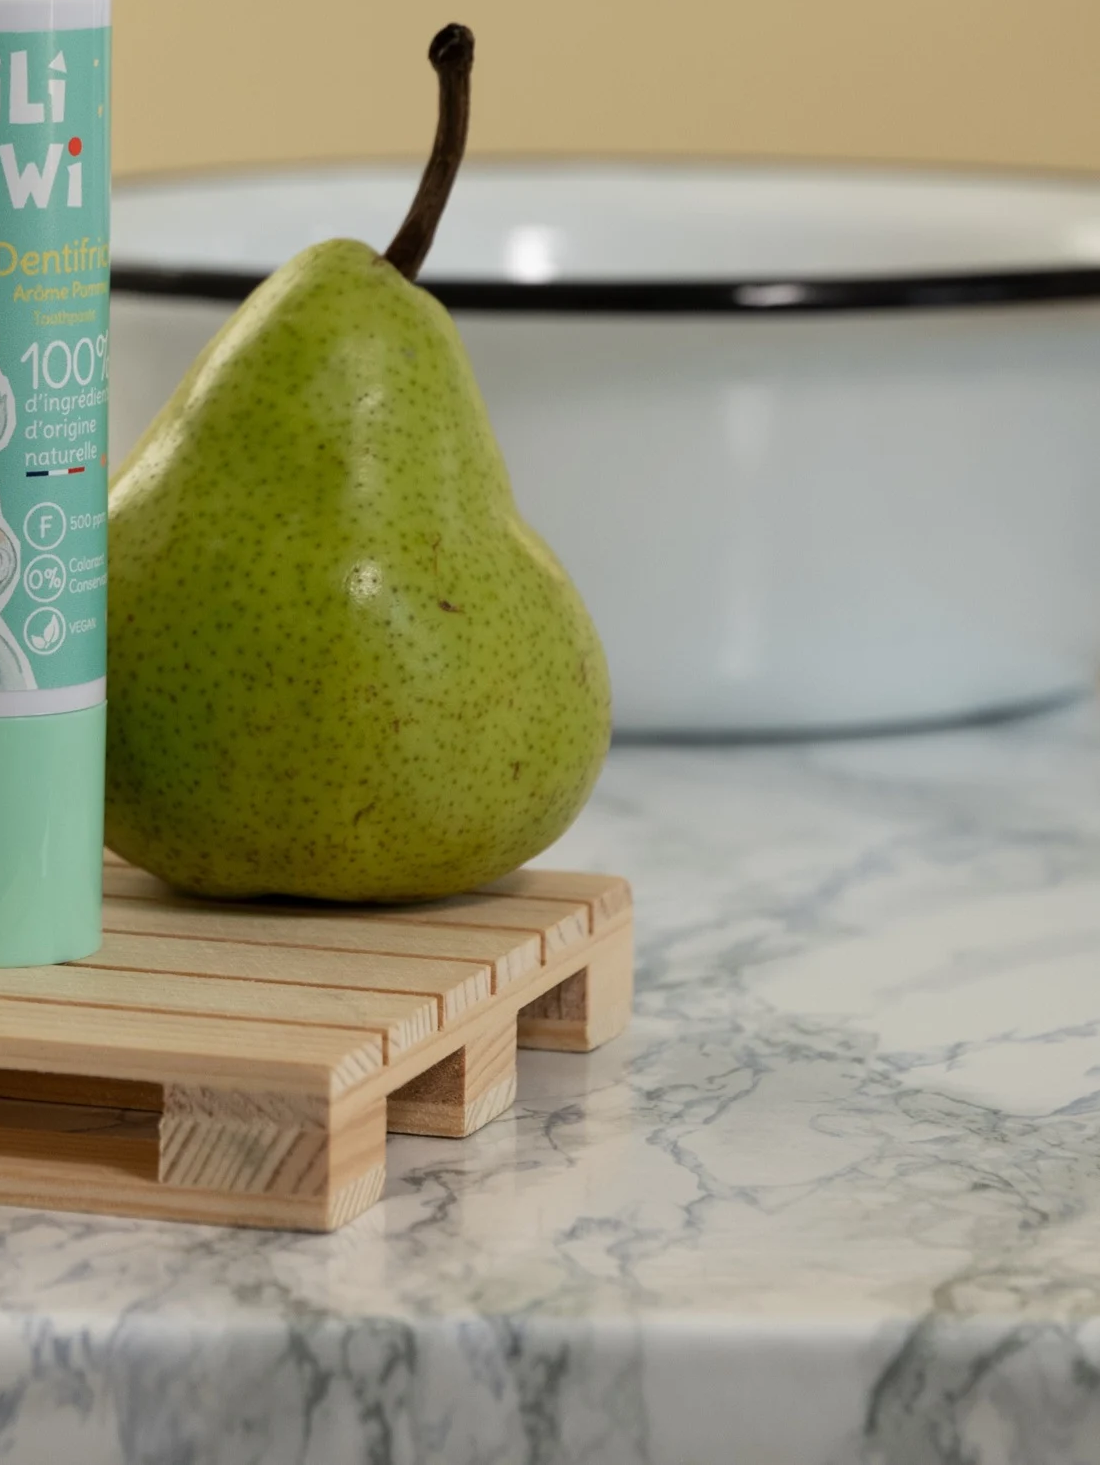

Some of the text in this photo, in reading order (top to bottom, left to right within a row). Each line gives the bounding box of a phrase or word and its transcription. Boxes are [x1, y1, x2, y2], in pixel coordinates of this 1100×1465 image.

[25, 387, 109, 416] d'ingrédien
[25, 416, 97, 442] d'origine
[25, 441, 97, 467] naturelle
[40, 515, 53, 539] F
[70, 514, 91, 531] 500
[29, 566, 62, 590] 0%
[69, 618, 97, 634] VEGAN
